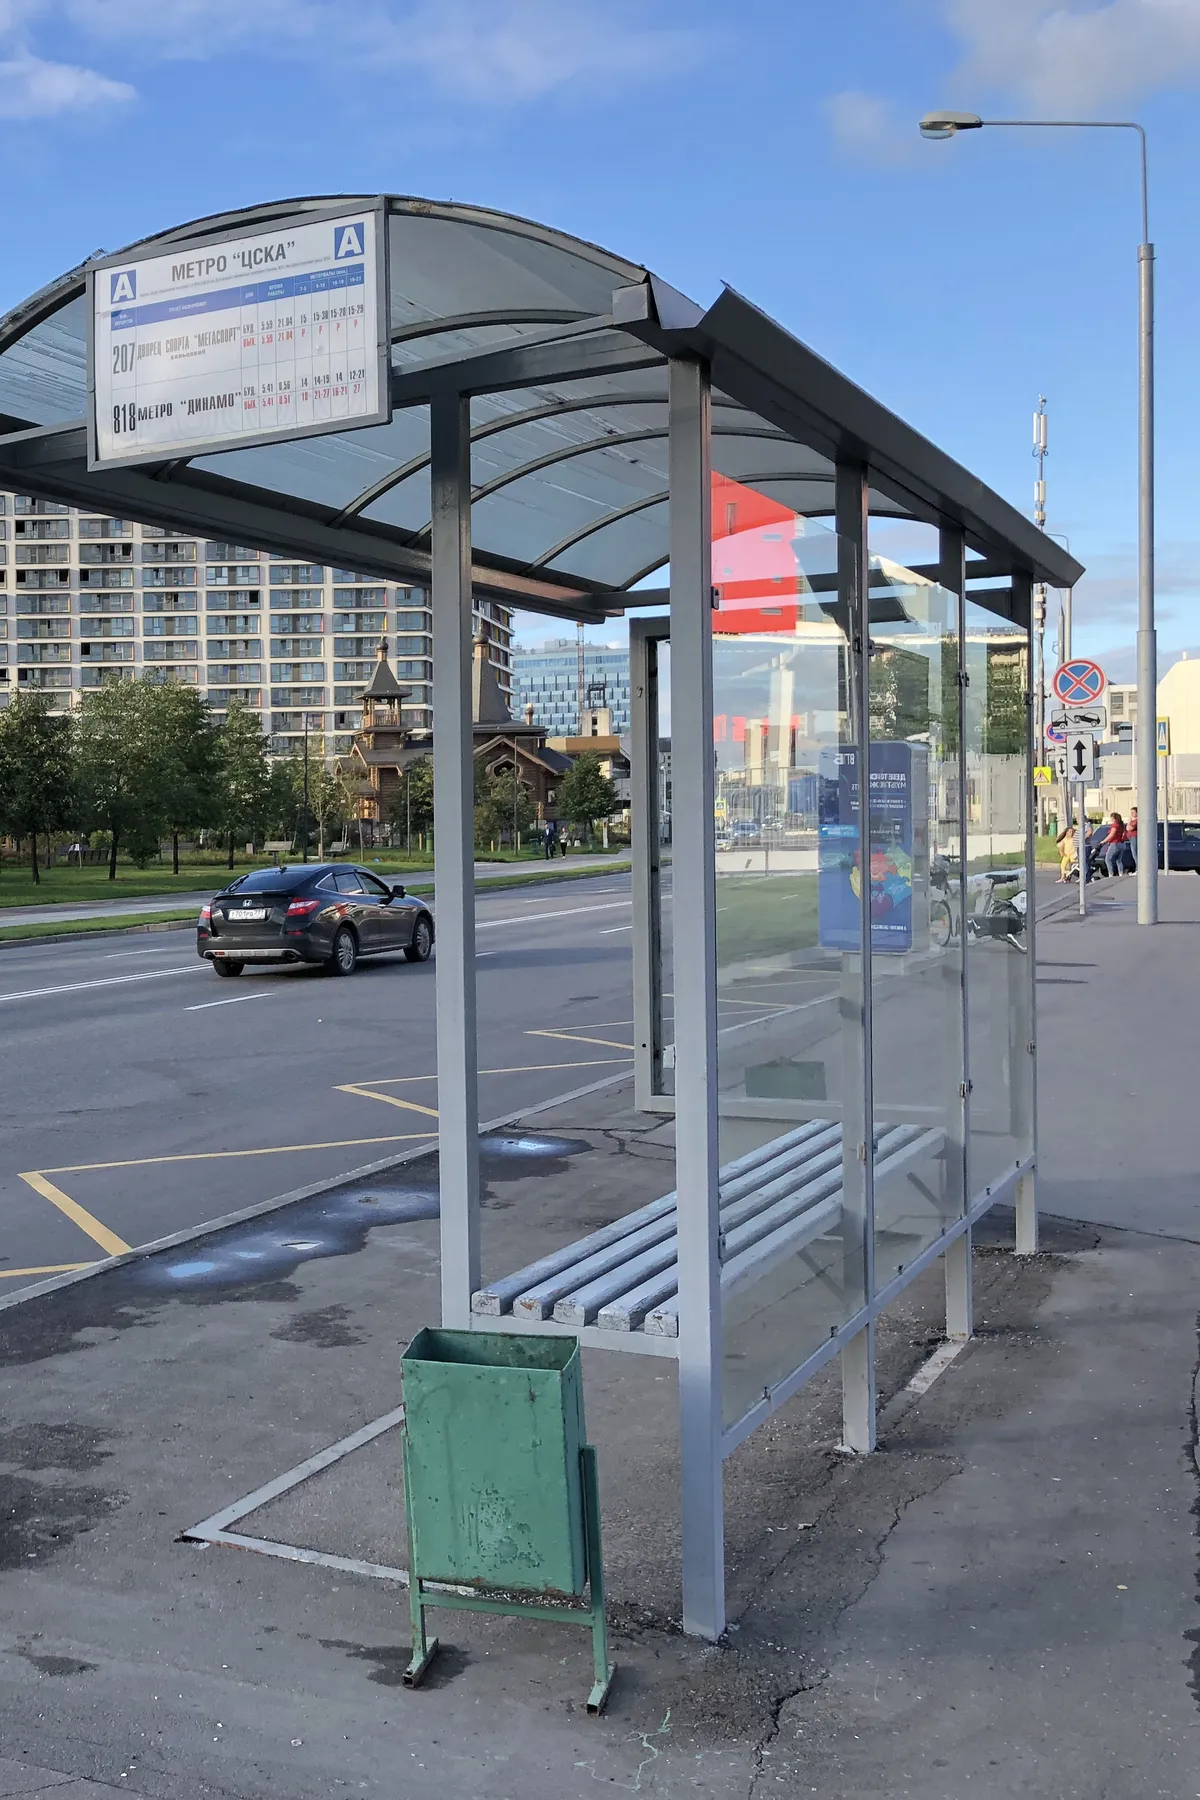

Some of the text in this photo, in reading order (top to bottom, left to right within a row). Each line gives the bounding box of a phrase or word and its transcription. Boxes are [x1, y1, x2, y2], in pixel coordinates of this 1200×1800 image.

[337, 226, 363, 258] А
[171, 255, 227, 282] МЕТРО
[112, 273, 135, 302] А
[300, 314, 307, 324] 15
[112, 342, 136, 375] 207
[137, 340, 162, 361] ДВОРЕЦ
[165, 336, 190, 353] СПОРТА
[261, 383, 274, 394] 5.41
[301, 378, 308, 388] 14
[336, 372, 343, 382] 14
[349, 369, 365, 380] 12-21
[262, 397, 274, 407] 5.41
[314, 388, 330, 400] 21-27
[353, 383, 361, 393] 27
[113, 402, 136, 434] 818
[137, 402, 173, 421] МЕТРО
